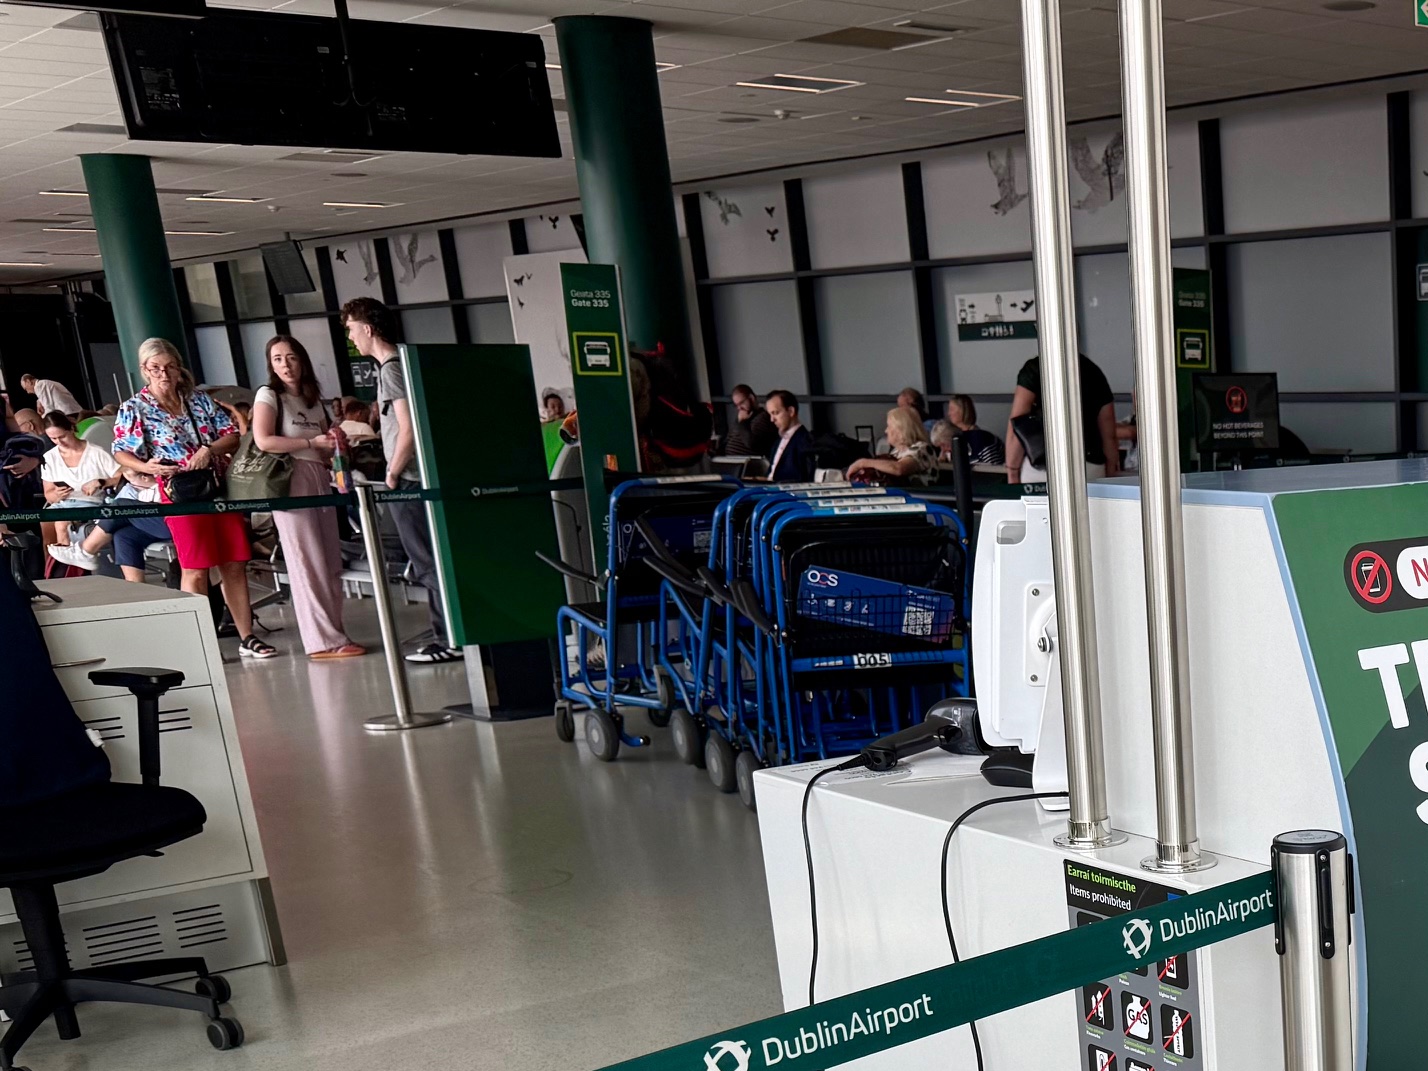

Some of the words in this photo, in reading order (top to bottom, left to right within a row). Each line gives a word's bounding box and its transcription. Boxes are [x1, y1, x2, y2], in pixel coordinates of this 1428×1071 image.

[571, 298, 591, 307] Gate
[592, 299, 609, 307] 335
[807, 569, 839, 587] OCS
[1091, 872, 1137, 893] toirmiscthe
[1069, 883, 1091, 900] Items
[1092, 892, 1132, 911] prohibited
[1159, 888, 1274, 942] DublinAirport
[1127, 1008, 1148, 1026] GAS
[762, 991, 935, 1068] DublinAirport
